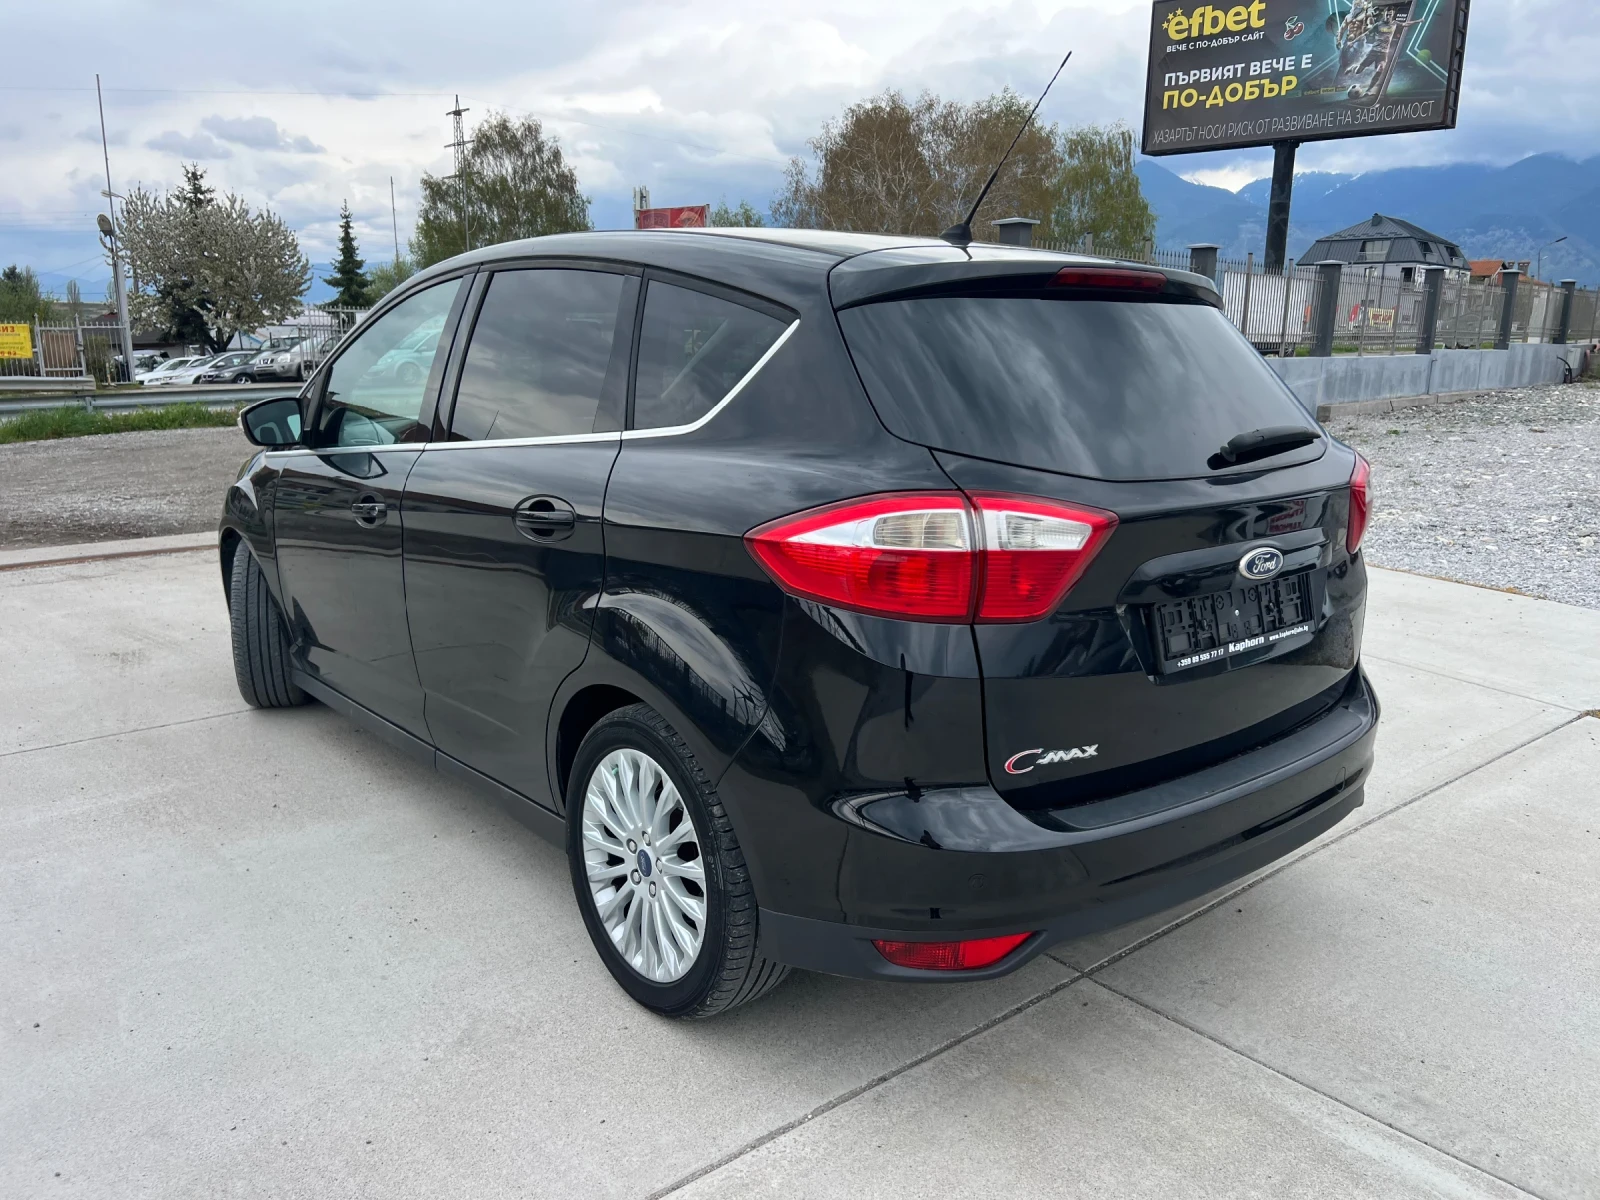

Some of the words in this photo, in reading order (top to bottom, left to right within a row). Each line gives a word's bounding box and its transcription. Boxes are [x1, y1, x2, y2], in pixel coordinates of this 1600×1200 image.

[1167, 0, 1267, 41] efbet
[1166, 43, 1187, 53] ВЕЧЕ
[1188, 42, 1195, 50] С
[1196, 35, 1240, 49] ПО-ДОБЪР
[1241, 30, 1265, 42] САЙТ
[1164, 63, 1246, 87] ПЪРВИЯТ
[1249, 55, 1296, 76] ВЕЧЕ
[1301, 53, 1313, 69] Е
[1162, 75, 1299, 110] ПО-ДОБЪР
[1152, 126, 1199, 145] ХАЗАРТЪТ
[1199, 123, 1226, 141] НОСИ
[1227, 120, 1255, 137] РИСК
[1256, 118, 1272, 135] ОТ
[1271, 111, 1335, 134] РАЗВИВАНЕ
[1336, 109, 1352, 126] НА
[1353, 100, 1436, 124] ЗАВИСИМОСТ
[1252, 553, 1278, 574] Ford
[1200, 652, 1211, 661] 555
[1210, 650, 1218, 658] 77
[1218, 648, 1225, 656] 17
[1228, 636, 1265, 653] Kaphorn
[1004, 744, 1099, 775] C-MAX
